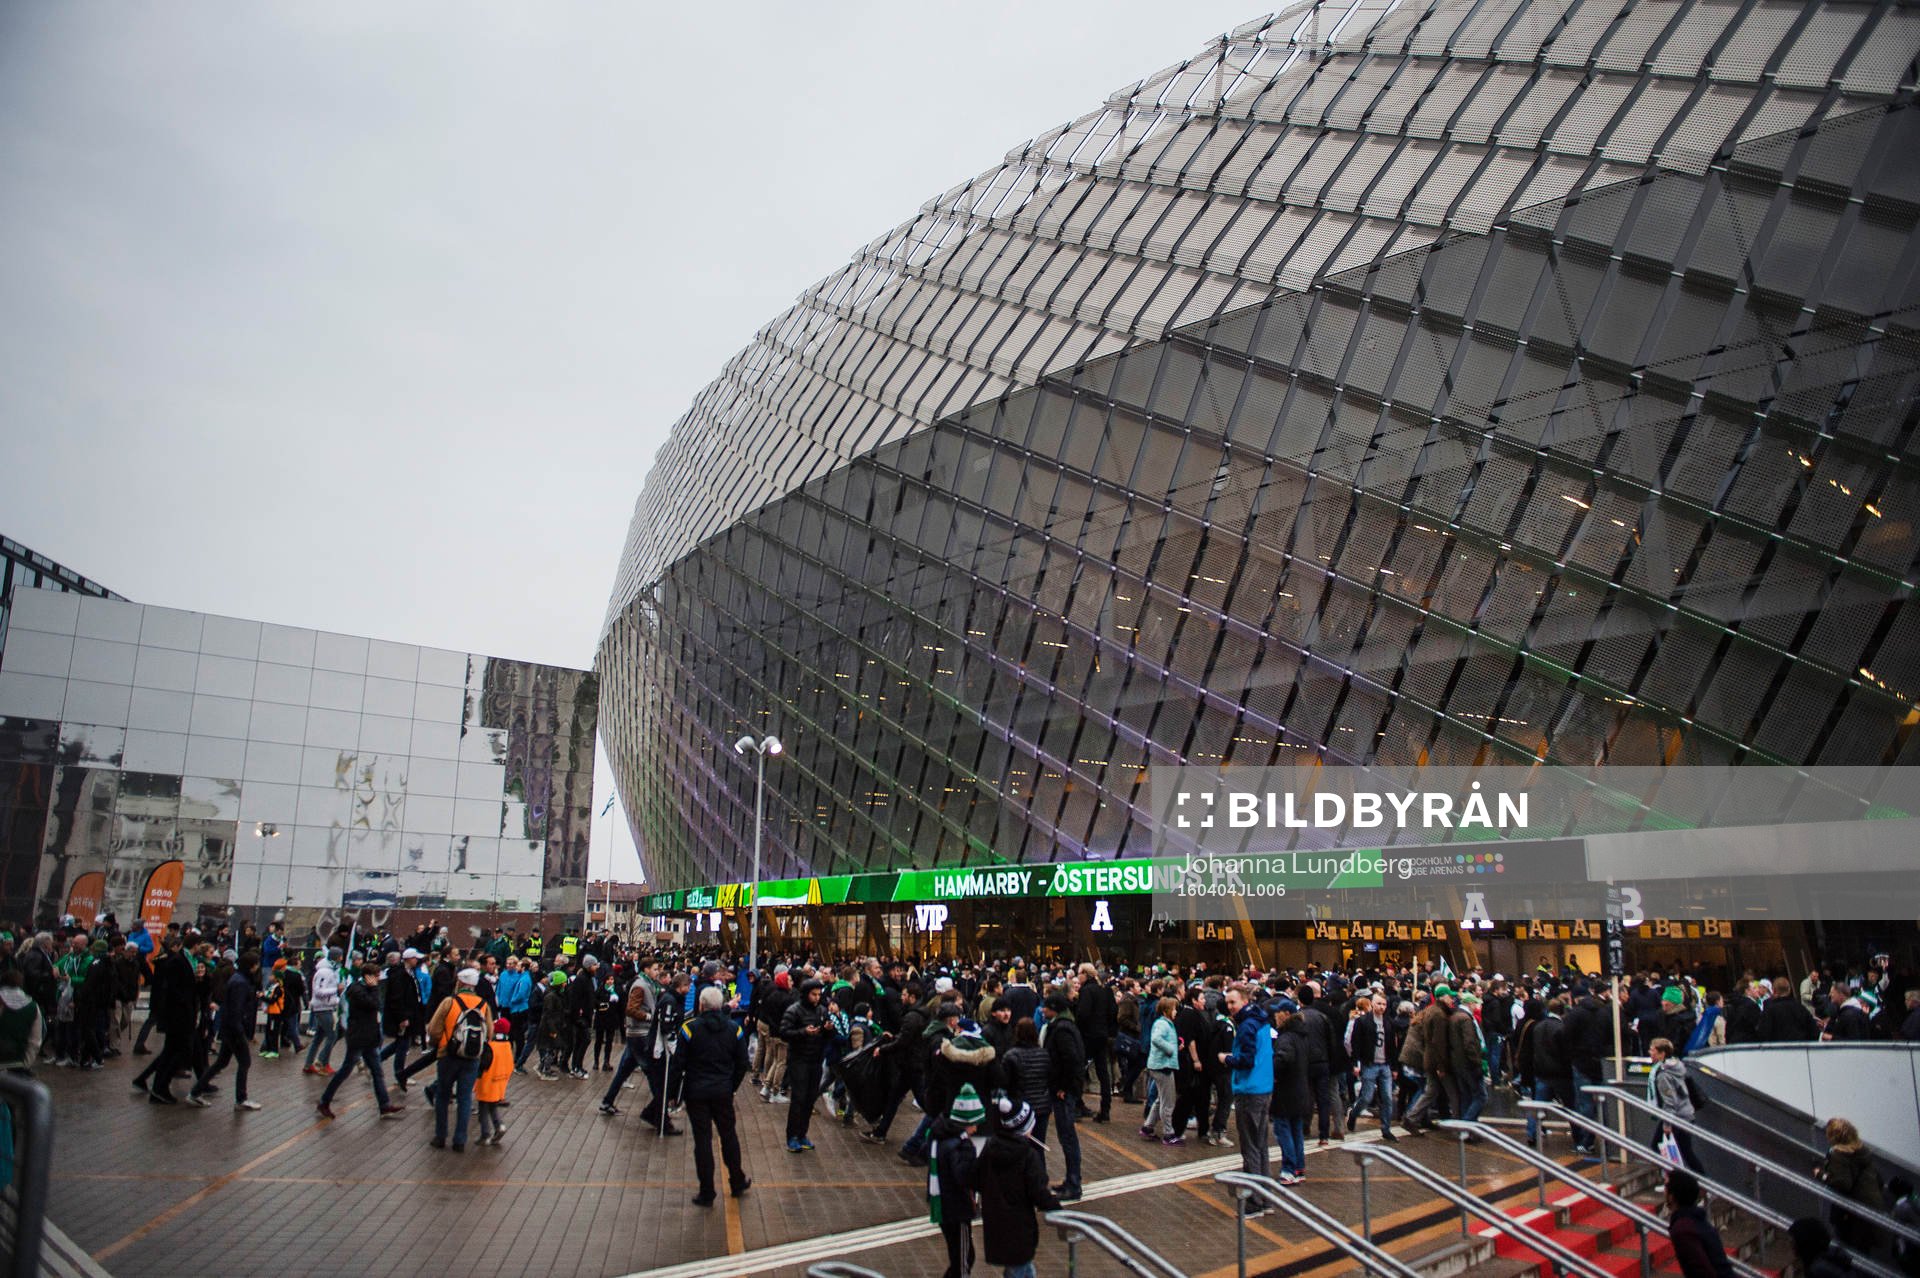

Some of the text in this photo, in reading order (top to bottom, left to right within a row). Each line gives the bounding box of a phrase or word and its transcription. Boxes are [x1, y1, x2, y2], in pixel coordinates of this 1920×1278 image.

[1401, 856, 1452, 866] SOCKHOLM
[1429, 865, 1464, 875] ARENAS
[934, 872, 1032, 897] HAMMARBY
[1054, 863, 1203, 893] ÖSTERSUNDS
[1212, 861, 1244, 888] FK
[1091, 900, 1113, 931] A
[1460, 892, 1495, 929] A
[1621, 887, 1644, 928] B
[915, 904, 948, 931] VIP
[1655, 917, 1670, 936] B
[1703, 917, 1719, 936] B
[1206, 922, 1217, 938] A
[1316, 921, 1330, 938] A
[1350, 921, 1364, 938] A
[1385, 920, 1399, 938] A
[1422, 920, 1437, 938] A
[1528, 919, 1545, 937] A
[1572, 918, 1589, 937] A
